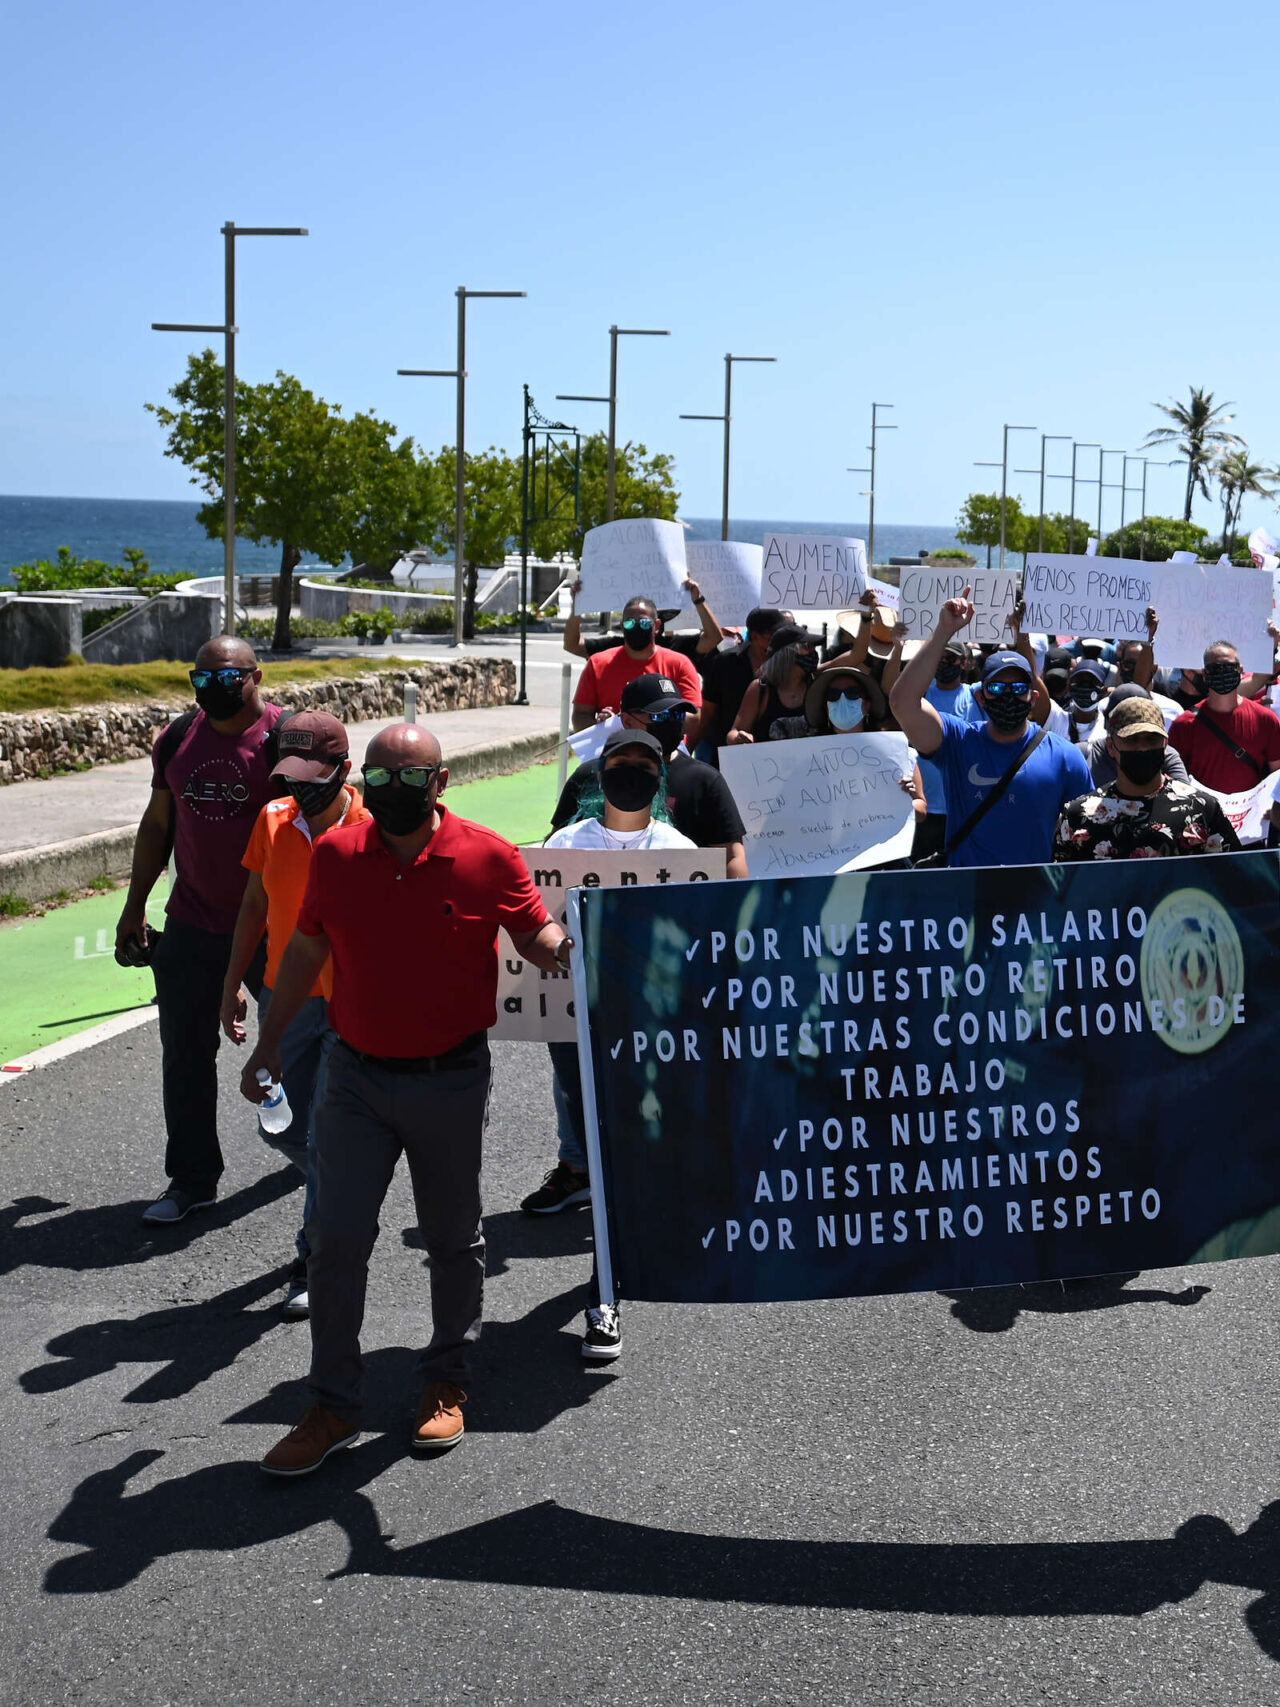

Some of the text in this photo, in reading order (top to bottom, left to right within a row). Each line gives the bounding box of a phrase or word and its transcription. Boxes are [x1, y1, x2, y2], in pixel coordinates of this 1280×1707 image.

[990, 578, 1015, 608] LA
[1023, 564, 1152, 602] MENOS PROMESAS
[902, 607, 1014, 640] PRESA
[181, 780, 250, 802] AERO
[747, 768, 904, 822] SIN AUMENTO
[750, 757, 788, 788] 12
[534, 868, 709, 888] mento
[711, 928, 781, 963] POR
[803, 917, 969, 958] NUESTRO
[991, 906, 1147, 947] SALARIO
[728, 954, 1137, 1011] POR NUESTRO RETIRO
[633, 993, 1246, 1062] POR NUESTRAS CONDICIONES DE
[841, 1059, 1005, 1101] TRABAJO
[799, 1100, 1080, 1152] POR NUESTROS
[755, 1146, 1102, 1203] ADIESTRAMIENTOS
[726, 1188, 1161, 1252] POR NUESTRO RESPETO
